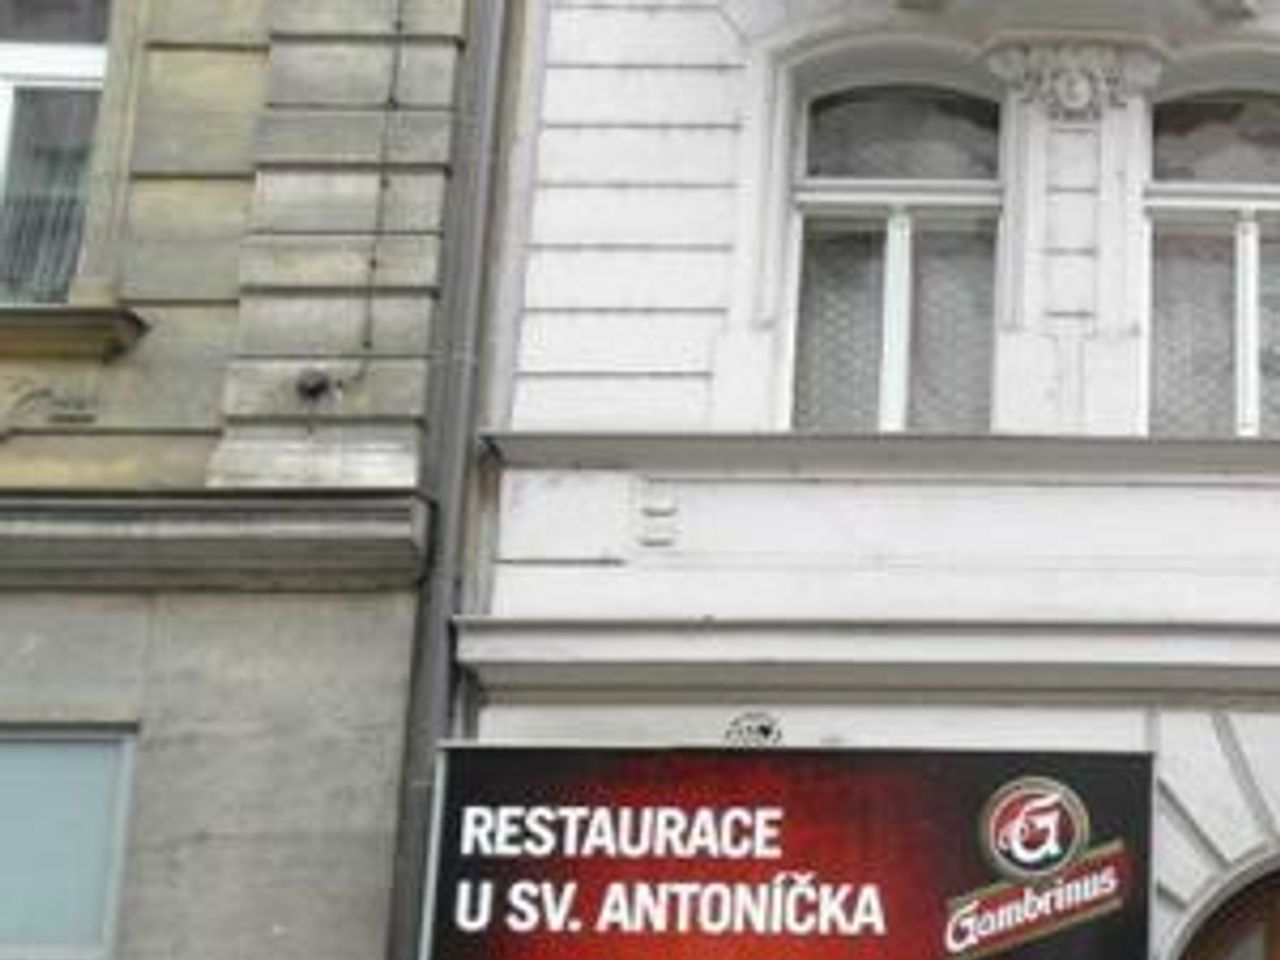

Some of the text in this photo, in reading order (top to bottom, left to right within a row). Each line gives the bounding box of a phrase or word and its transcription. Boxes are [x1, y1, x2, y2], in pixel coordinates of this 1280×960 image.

[461, 806, 782, 859] RESTAURACE
[455, 871, 886, 936] U SV. ANTONÍČKA
[944, 865, 1117, 952] Gambrinus
